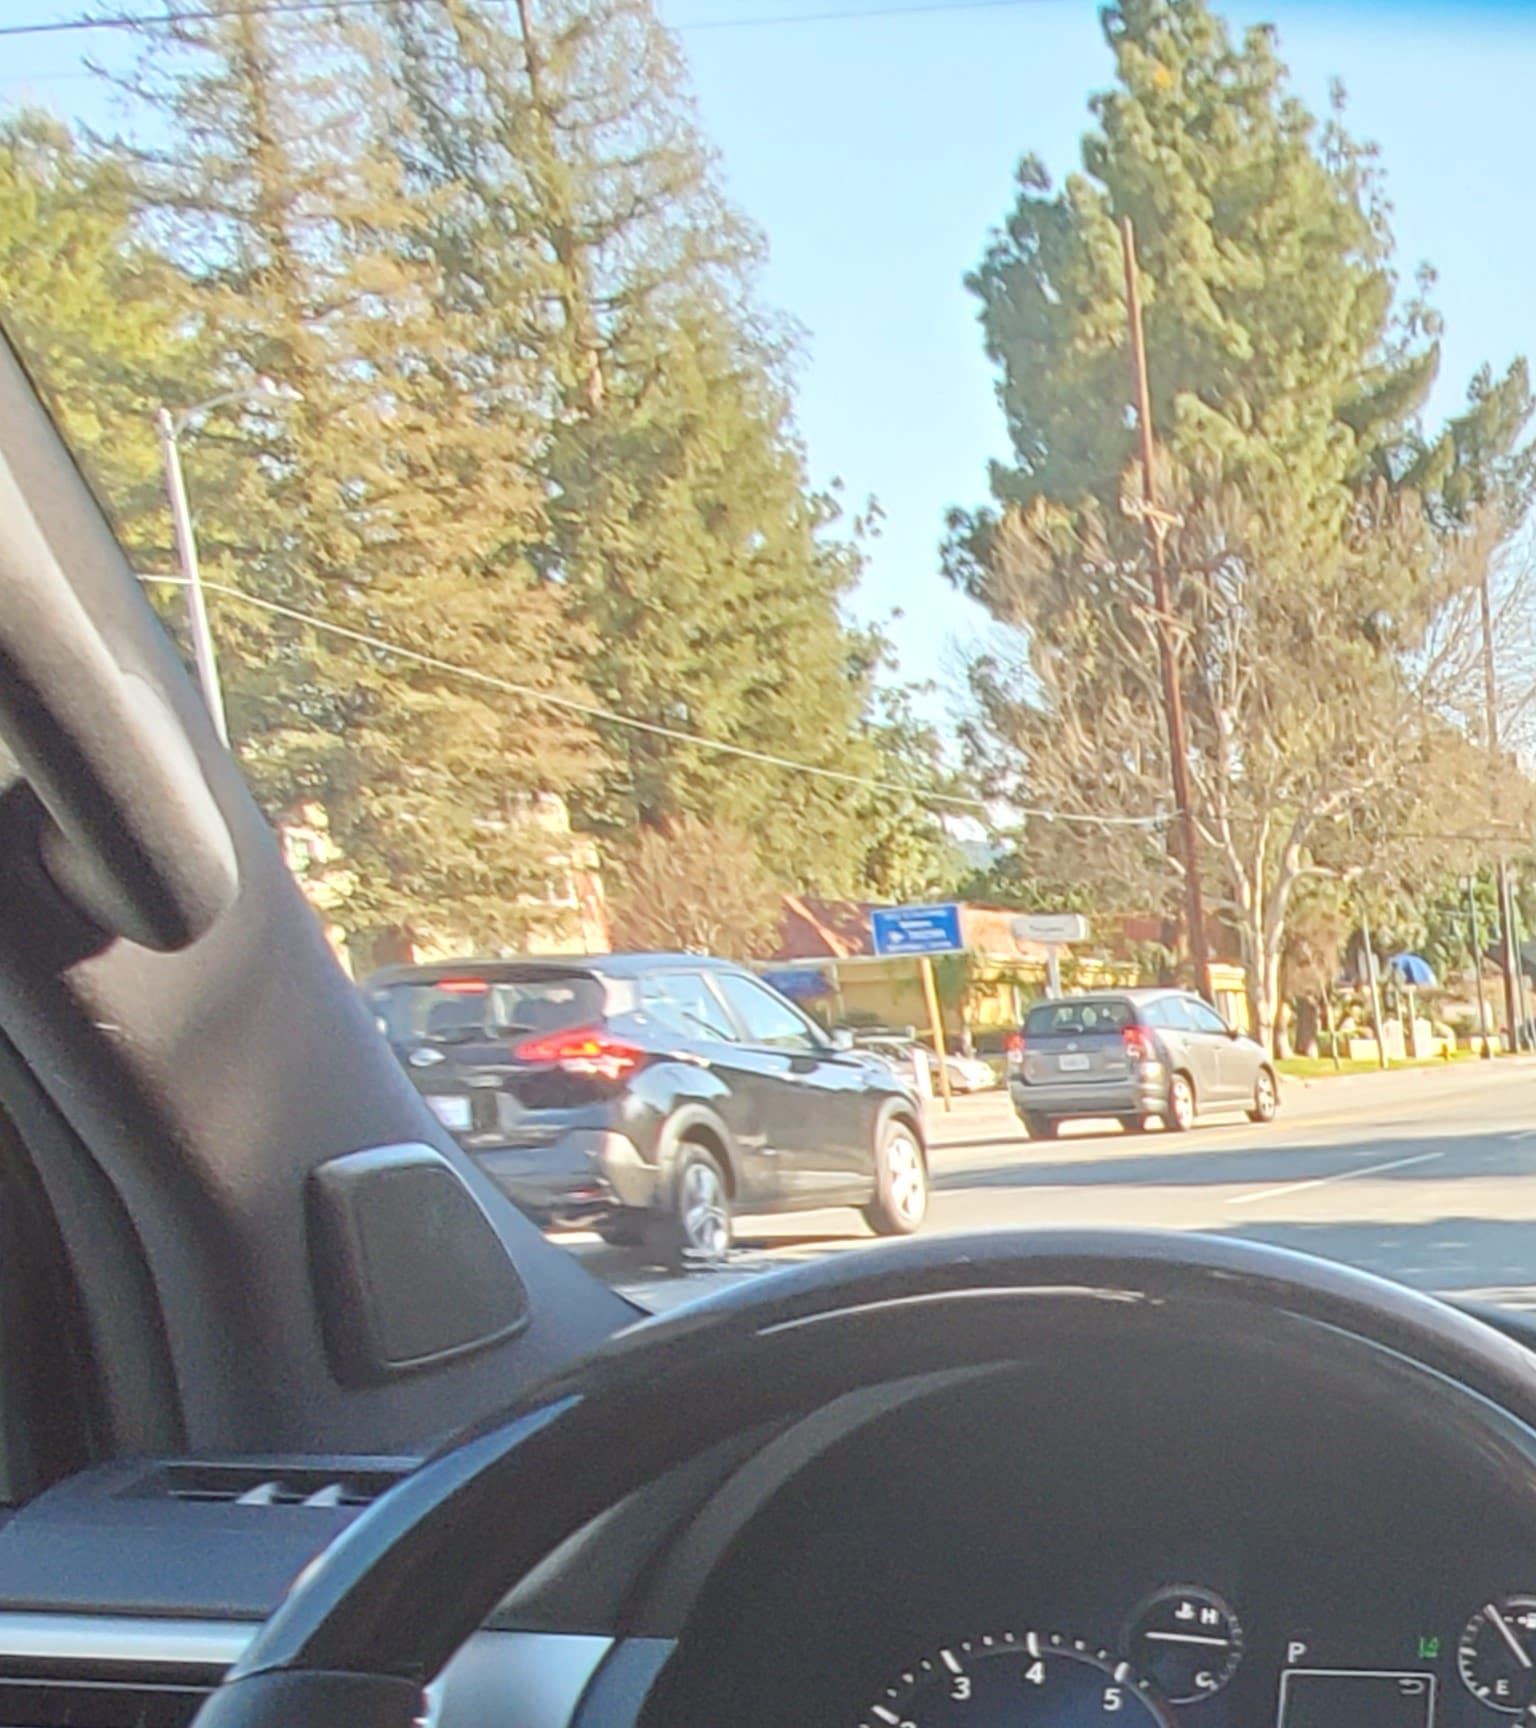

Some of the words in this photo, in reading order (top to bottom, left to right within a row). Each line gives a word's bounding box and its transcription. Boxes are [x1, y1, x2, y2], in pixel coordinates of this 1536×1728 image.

[1288, 1642, 1306, 1663] P
[1026, 1662, 1045, 1685] 4
[952, 1677, 972, 1700] 3
[1496, 1680, 1510, 1695] E
[1104, 1689, 1121, 1712] 5
